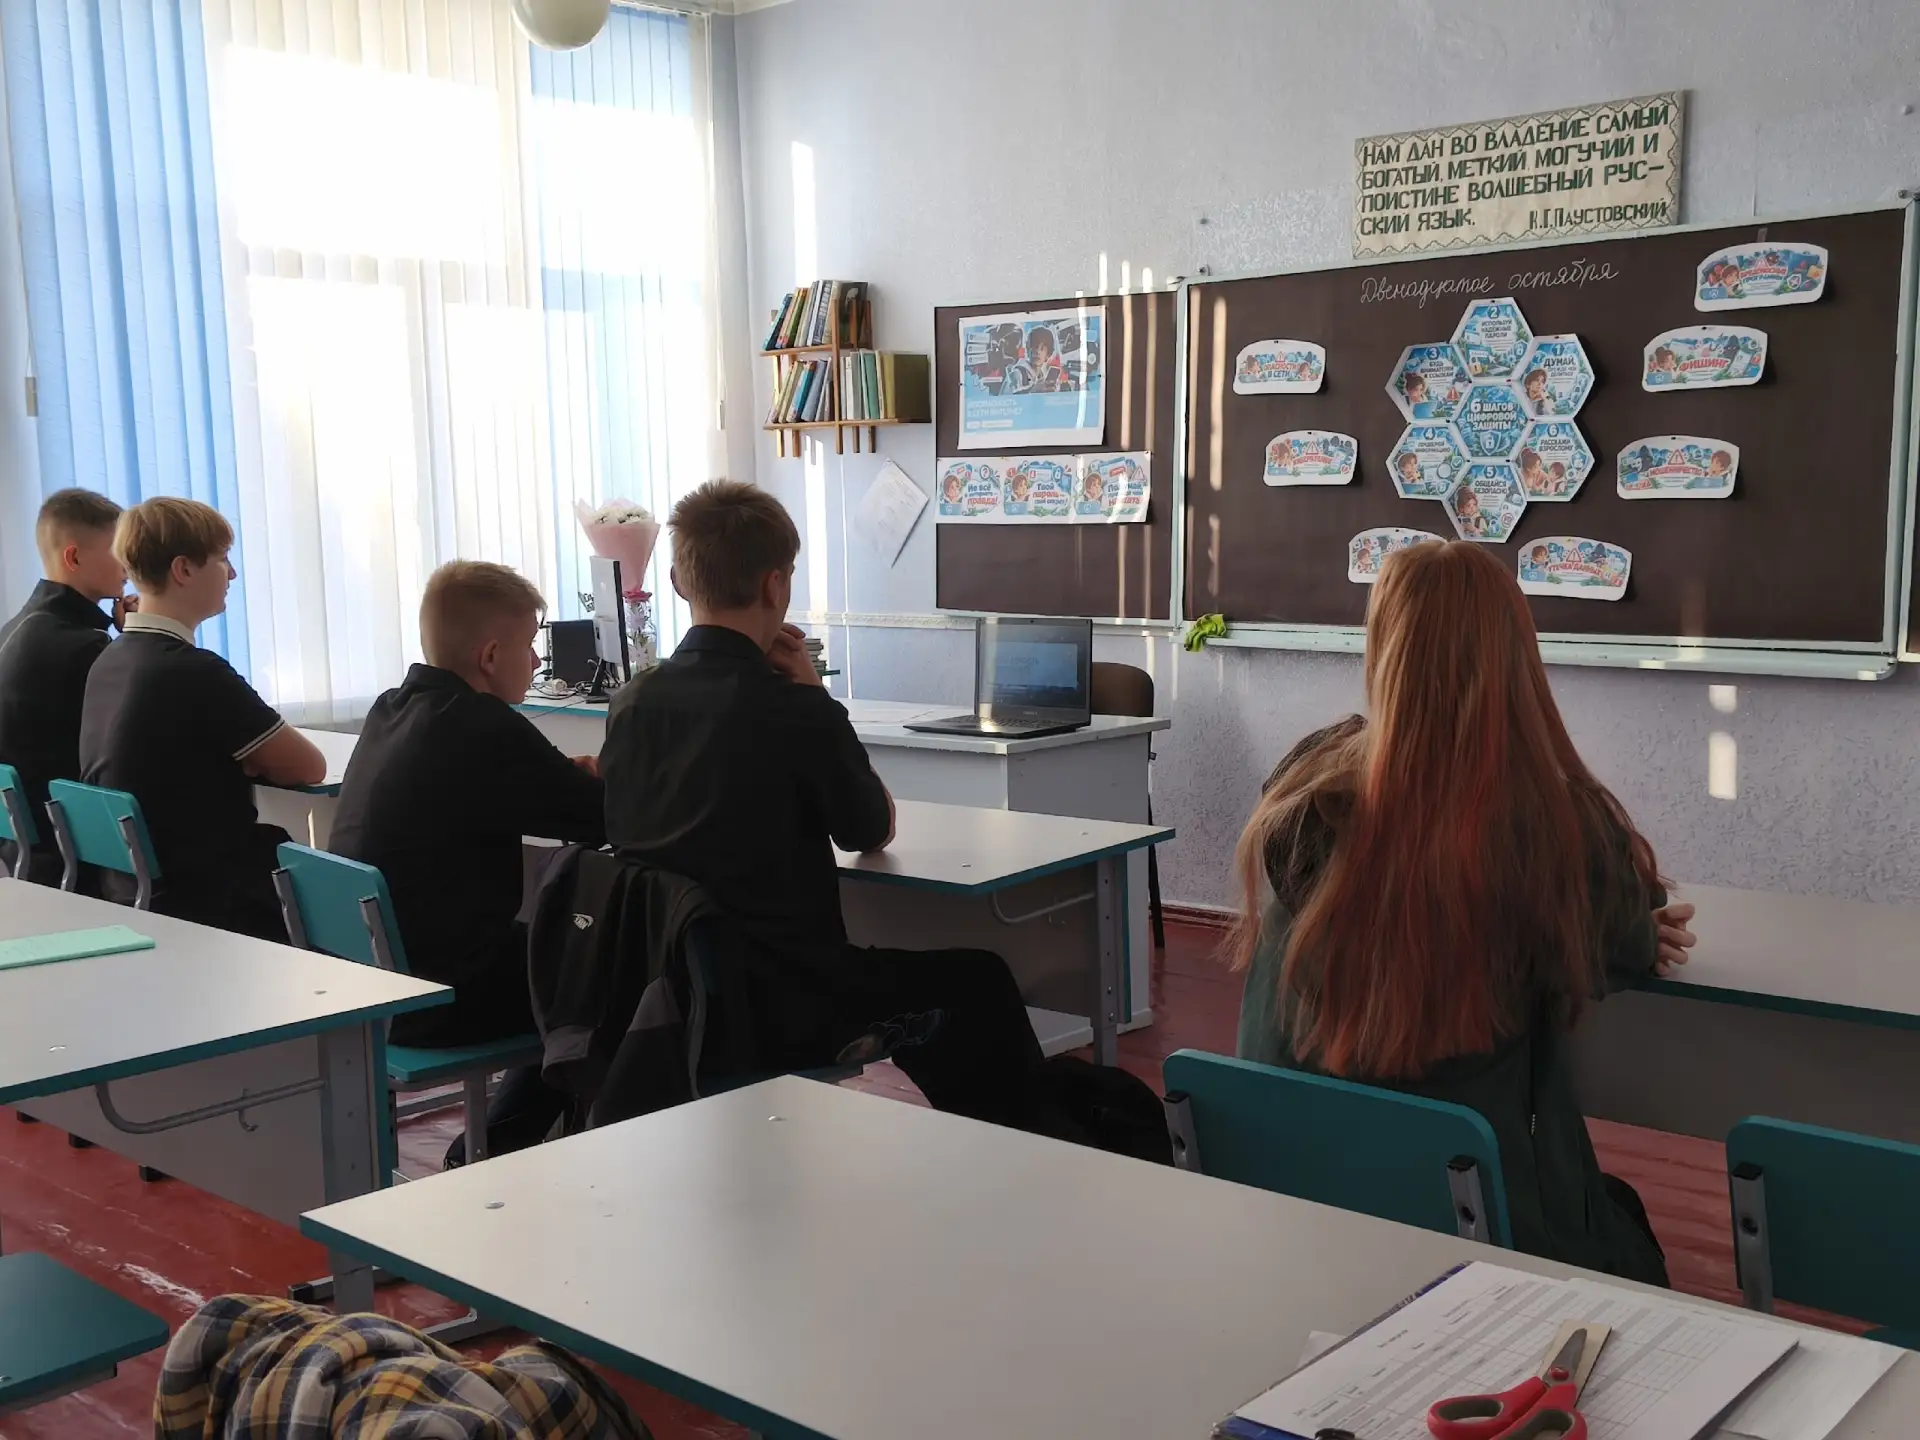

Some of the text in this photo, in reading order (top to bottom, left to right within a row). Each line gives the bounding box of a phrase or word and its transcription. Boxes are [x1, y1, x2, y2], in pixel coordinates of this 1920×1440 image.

[1362, 104, 1668, 167] НАМ ДАН ВО ВЛАДЕНИЕ САМЫЙ
[1361, 164, 1443, 190] БОГАТЫЙ,
[1535, 134, 1634, 168] МОГУЧИЙ
[1644, 133, 1658, 153] И
[1361, 185, 1458, 213] ПОИСТИНЕ
[1468, 166, 1593, 201] ВОЛШЕБНЫЙ
[1360, 208, 1475, 236] СКИЙ ЯЗЫК.
[1361, 258, 1619, 308] Двенадцатое октября
[1490, 306, 1498, 318] 2
[1429, 347, 1437, 359] 3
[1554, 344, 1561, 355] 1
[1680, 359, 1729, 371] ФИШИНГ
[1471, 399, 1514, 413] 6 ШАГОВ
[1466, 410, 1517, 423] ЦИФРОВОЙ
[1472, 421, 1511, 430] ЗАЩИТЫ
[1549, 423, 1557, 436] 6
[1425, 427, 1433, 439] 4
[1486, 466, 1494, 477] 5
